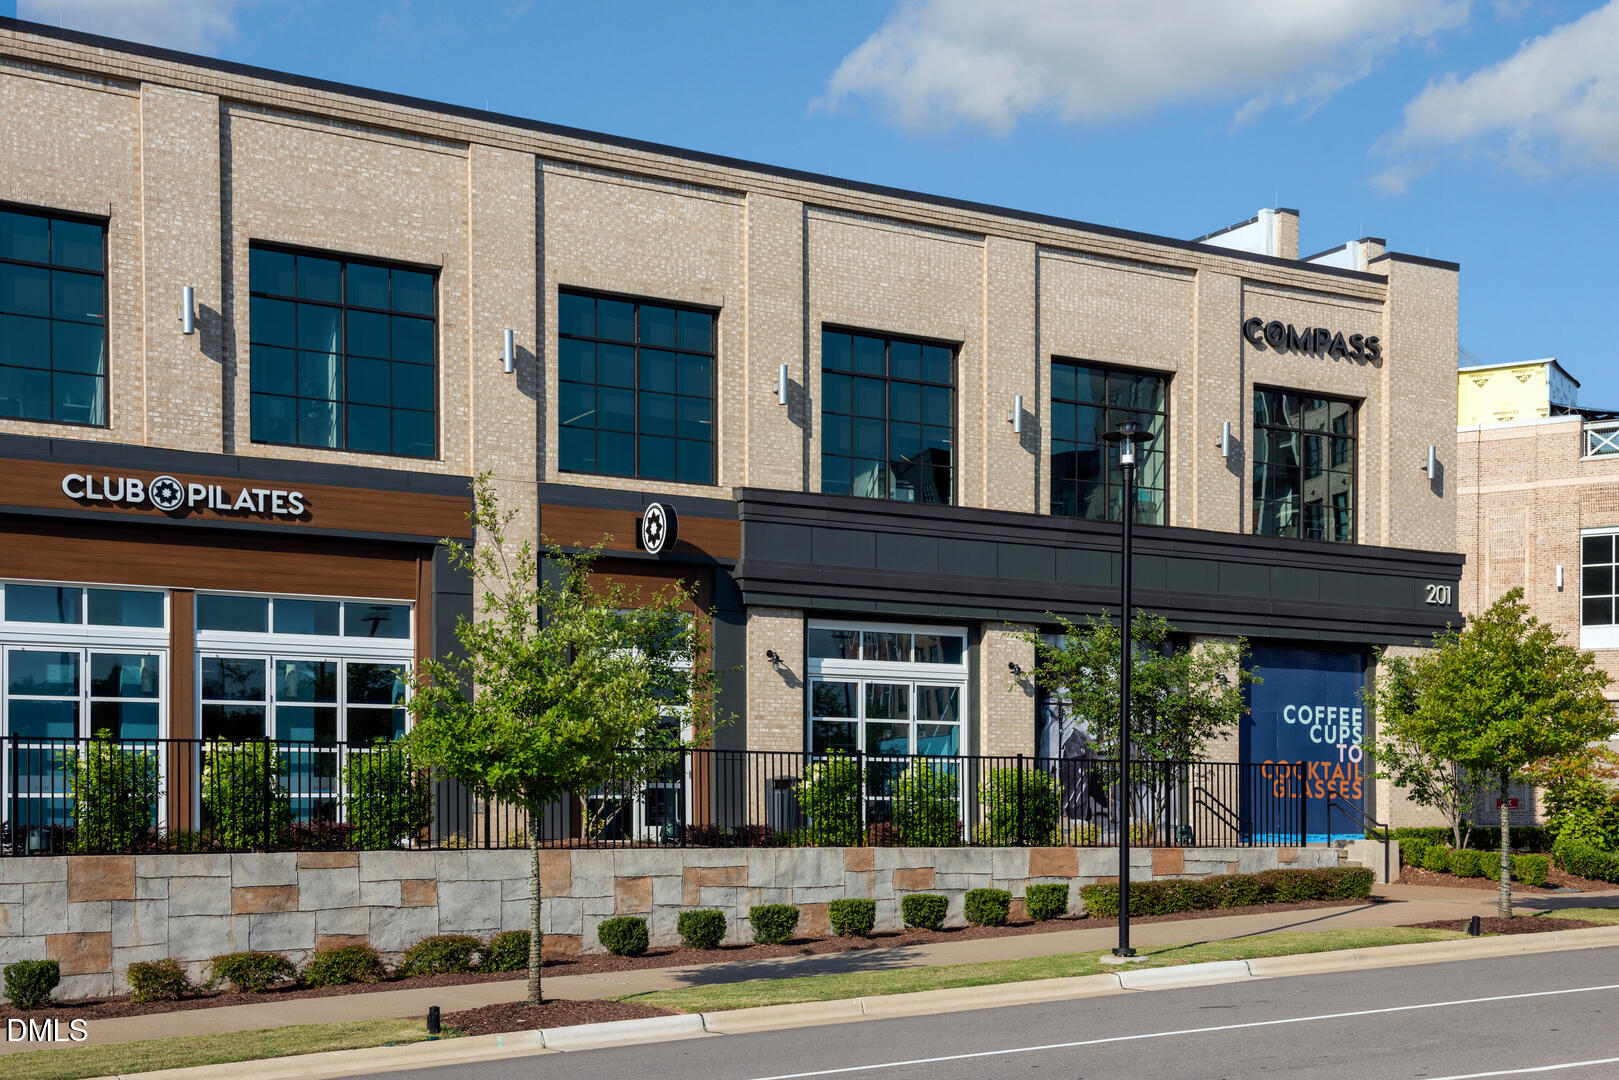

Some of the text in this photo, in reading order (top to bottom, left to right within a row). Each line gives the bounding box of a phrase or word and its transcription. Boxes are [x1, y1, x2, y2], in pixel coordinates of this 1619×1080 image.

[1243, 317, 1380, 360] COMPASS
[61, 473, 304, 515] CLUB PILATES
[1425, 584, 1451, 605] 201
[1283, 704, 1362, 727] COFFEE
[1310, 724, 1363, 745] CUPS
[1336, 743, 1363, 763] TO
